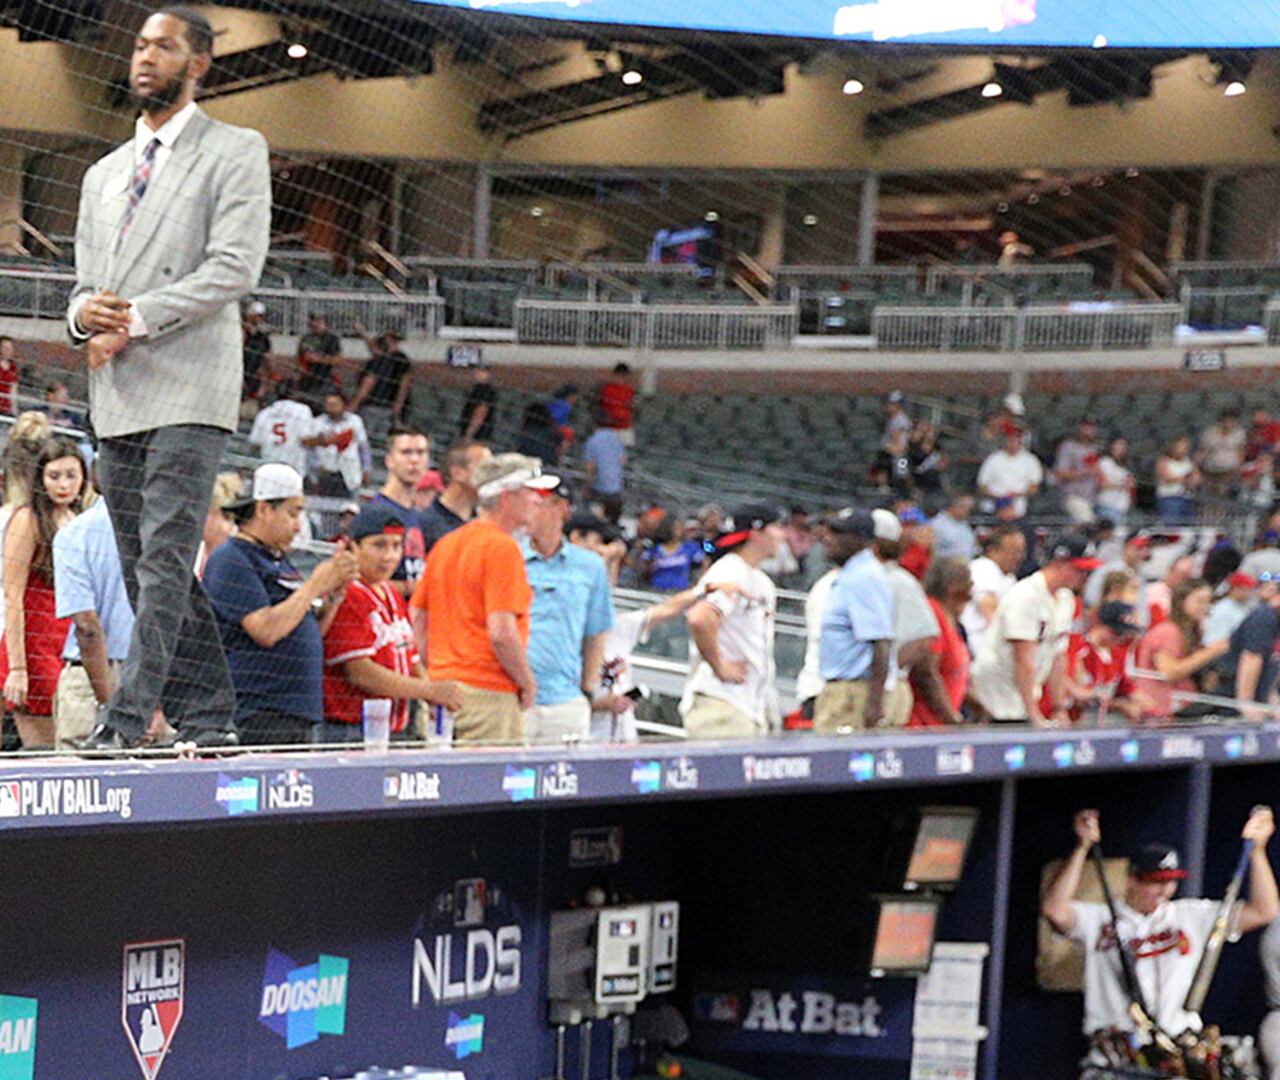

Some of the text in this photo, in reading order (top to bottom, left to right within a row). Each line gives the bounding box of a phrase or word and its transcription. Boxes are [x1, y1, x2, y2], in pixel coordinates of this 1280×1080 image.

[269, 785, 313, 809] NLDS
[127, 945, 180, 992] MLB
[413, 925, 522, 1008] NLDS
[126, 985, 180, 1005] NETWORK
[259, 973, 348, 1018] DOOSAN
[743, 989, 881, 1037] At Bat
